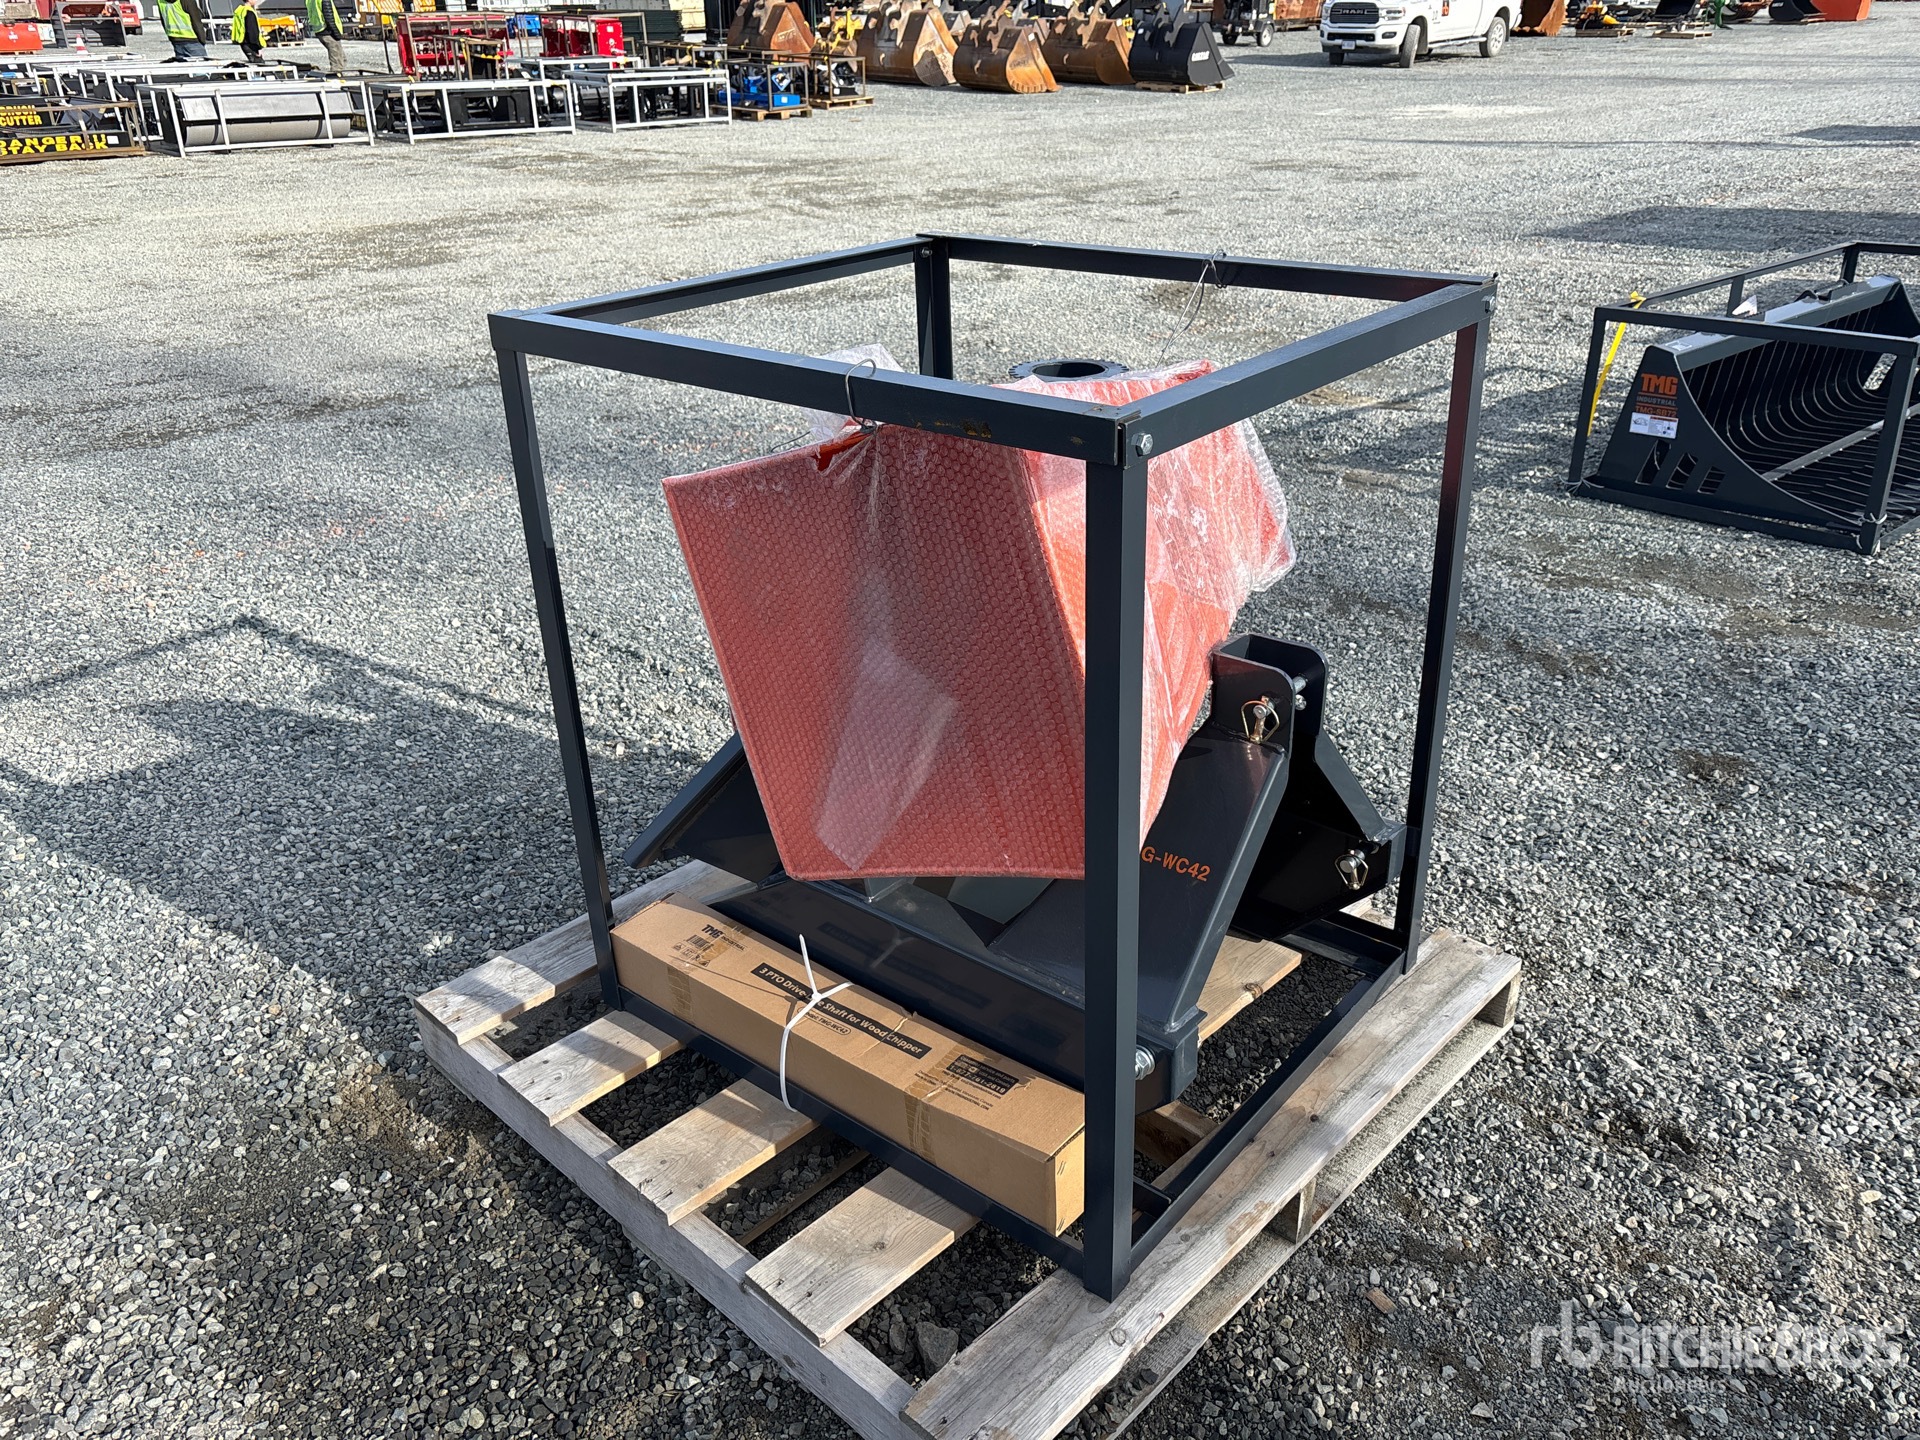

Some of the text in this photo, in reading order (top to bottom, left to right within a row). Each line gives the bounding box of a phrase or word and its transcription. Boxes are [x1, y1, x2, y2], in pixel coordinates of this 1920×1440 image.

[0, 115, 43, 126] CUTTER
[0, 144, 47, 156] STAY
[1641, 373, 1679, 395] TMG
[1636, 395, 1677, 407] INDUSTRIAL
[1635, 406, 1677, 417] TMG-SB72
[1141, 846, 1211, 882] G-WC42
[701, 923, 724, 939] TMG
[721, 935, 745, 951] INDUSTRIAL
[759, 967, 767, 975] 3
[765, 970, 785, 983] PTO
[823, 1002, 848, 1018] Shaft
[845, 1013, 862, 1024] for
[860, 1020, 889, 1038] Wood
[886, 1034, 923, 1054] Chipper
[819, 1017, 849, 1034] TMG-WC42
